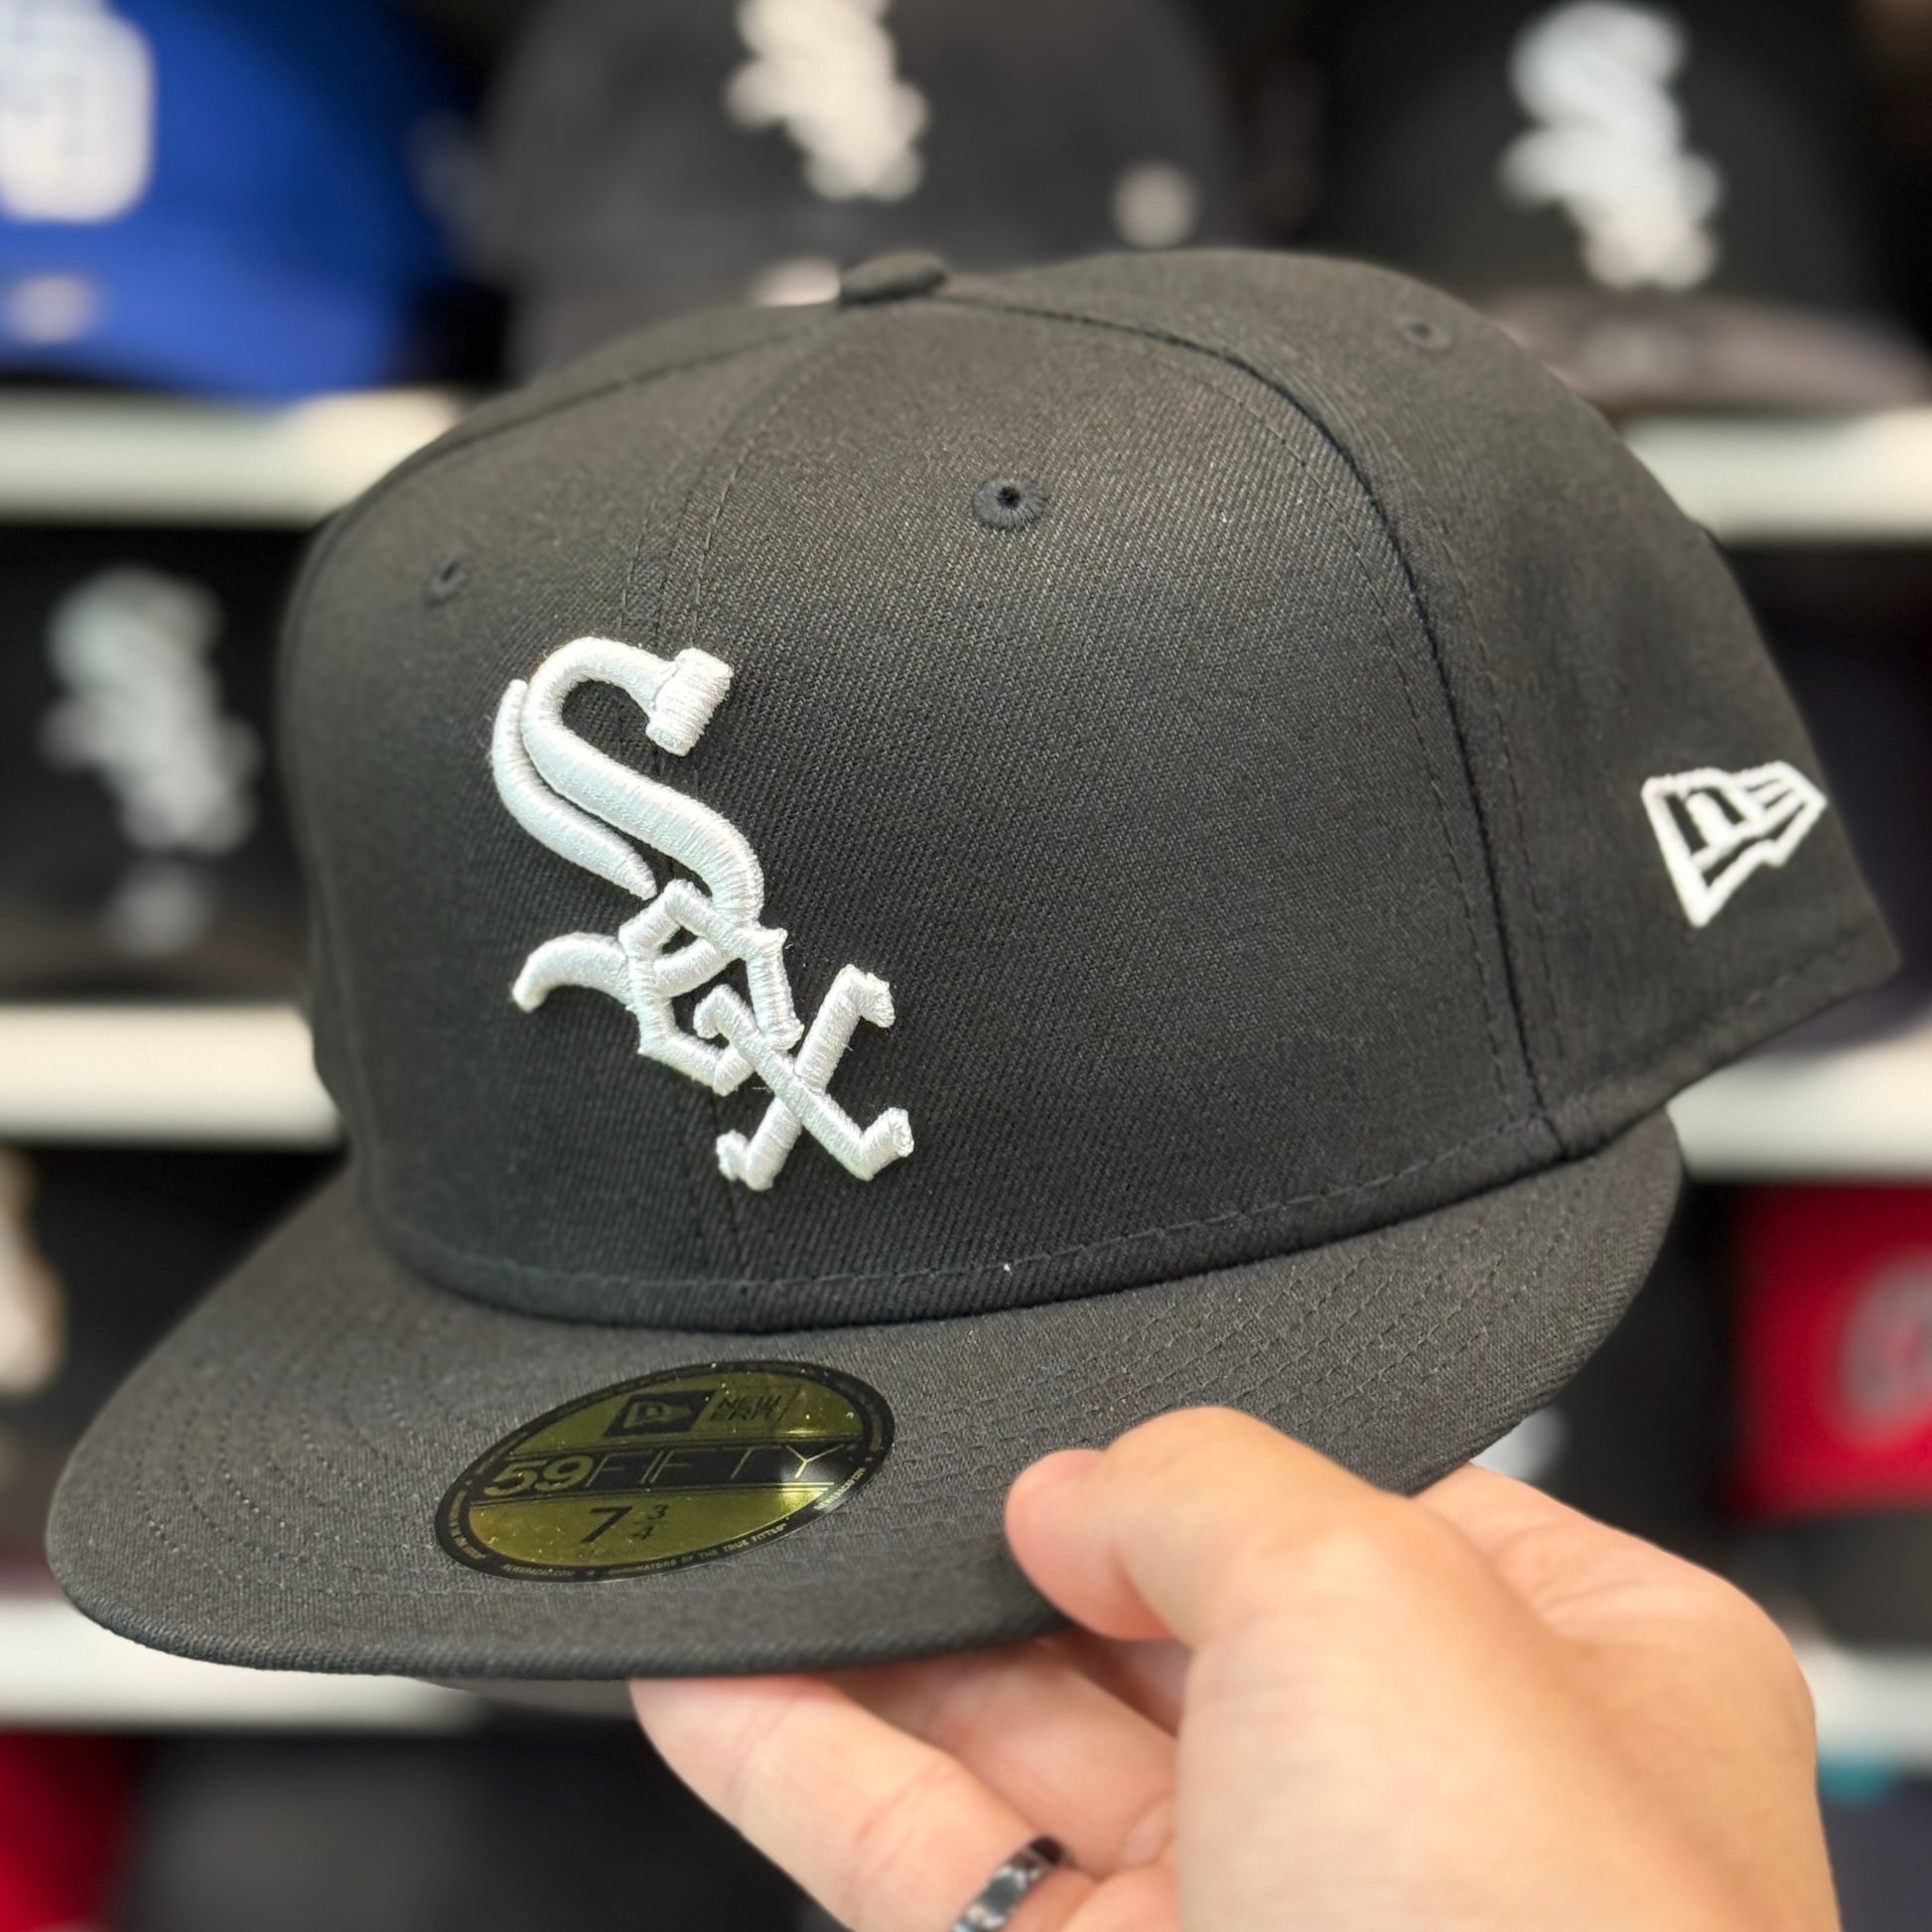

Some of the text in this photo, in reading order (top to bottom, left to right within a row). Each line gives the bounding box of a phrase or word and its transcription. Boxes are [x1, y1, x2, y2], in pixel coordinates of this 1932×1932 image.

[483, 1445, 845, 1497] 59FIFTY
[581, 1505, 633, 1543] 7
[723, 1539, 750, 1553] TRUE
